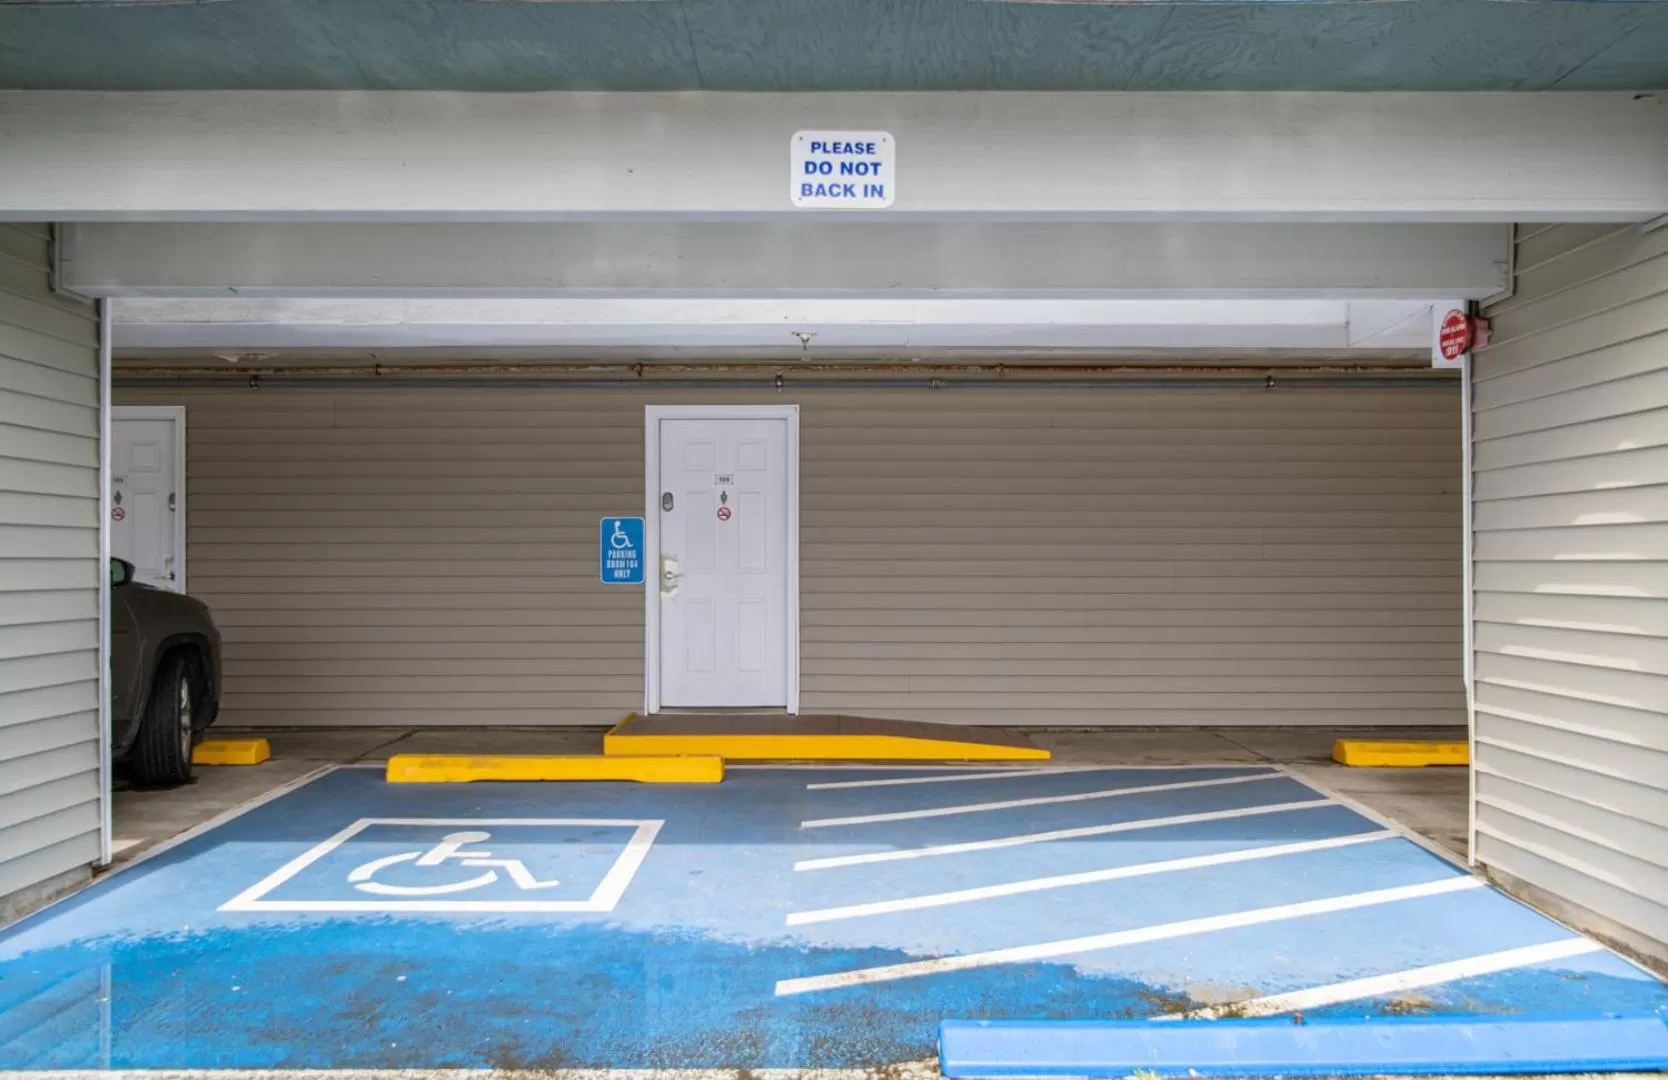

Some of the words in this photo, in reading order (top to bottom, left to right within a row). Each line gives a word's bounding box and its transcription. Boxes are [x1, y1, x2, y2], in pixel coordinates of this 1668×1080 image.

[810, 141, 876, 155] PLEASE
[804, 160, 833, 175] DO
[840, 161, 882, 176] NOT
[801, 183, 856, 198] BACK
[863, 183, 884, 198] IN
[608, 550, 637, 559] PARKING
[614, 569, 631, 578] ONLY
